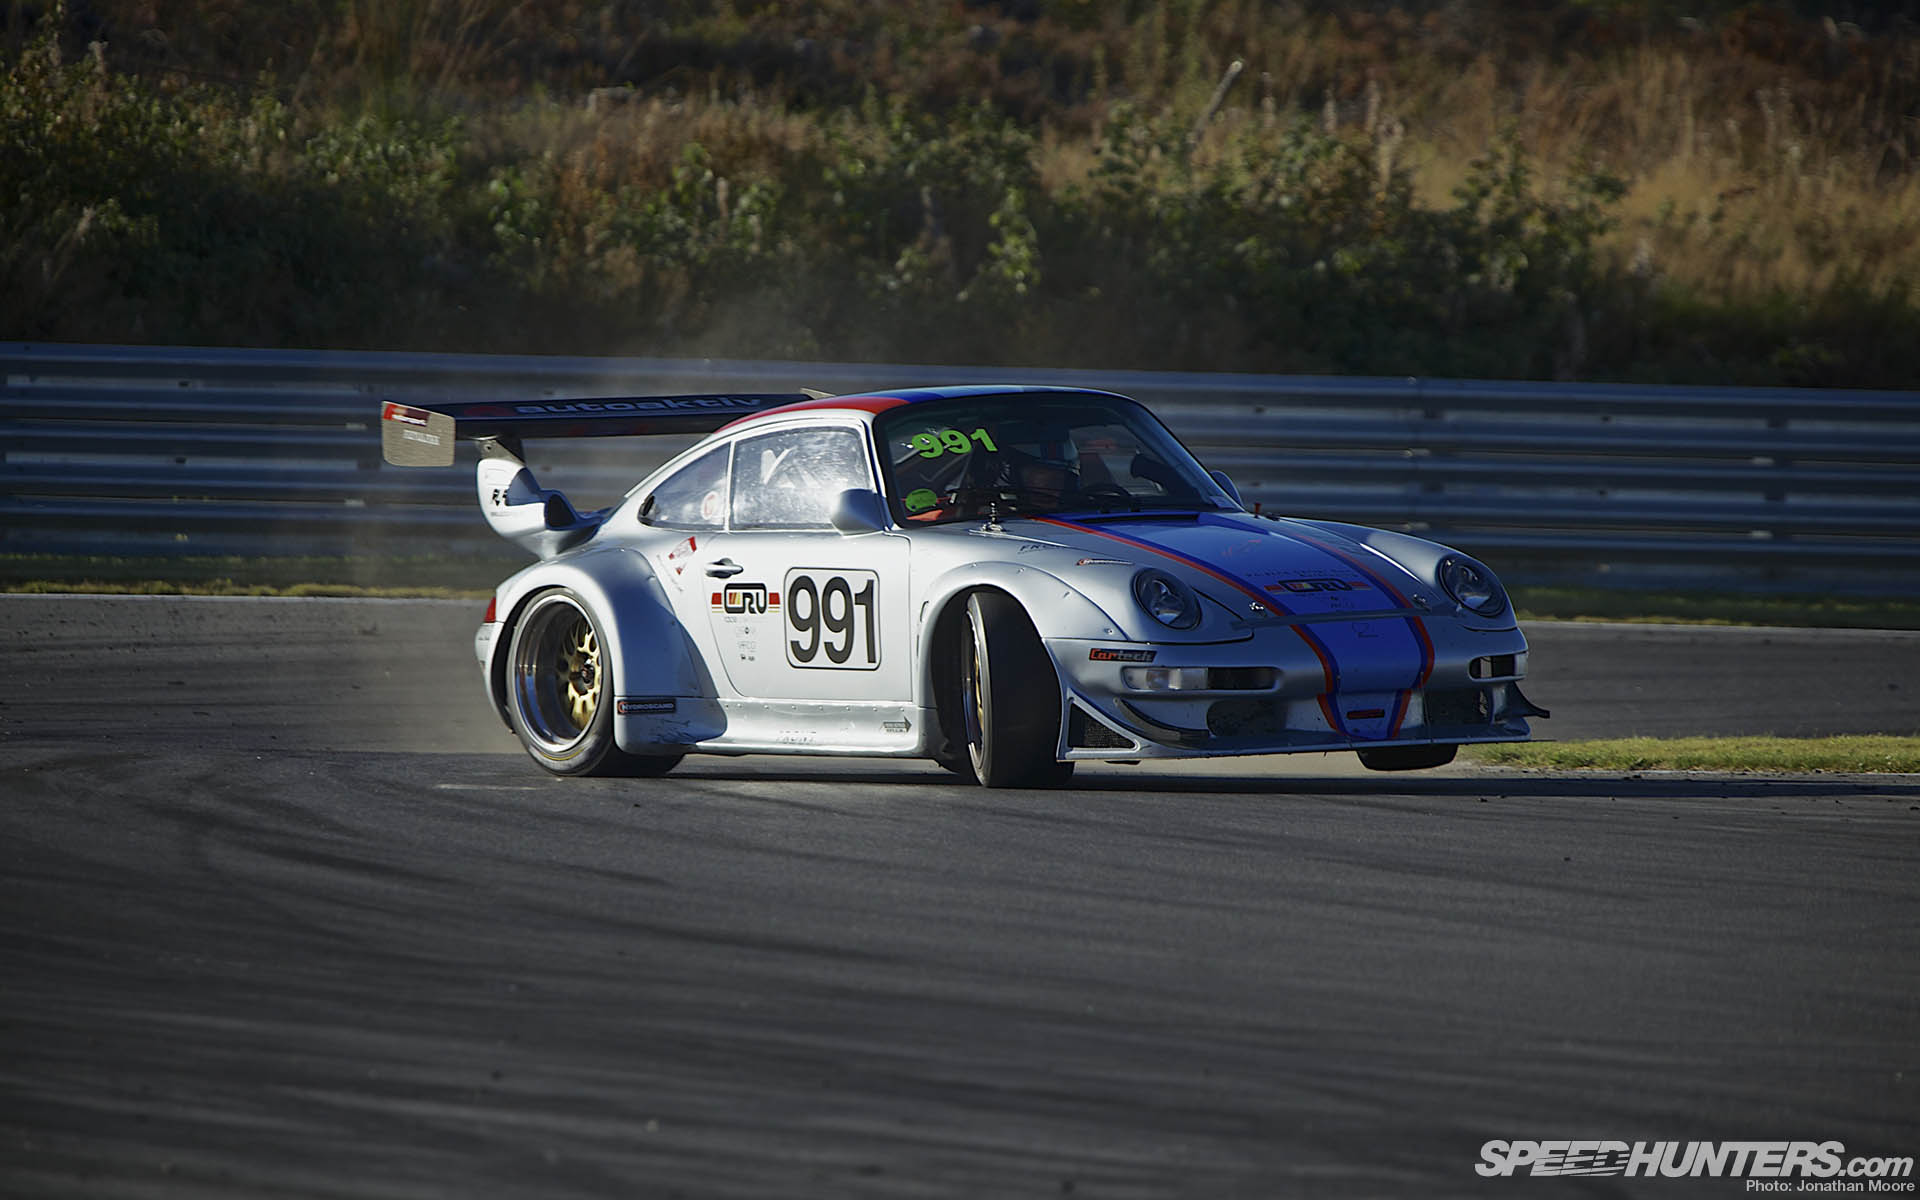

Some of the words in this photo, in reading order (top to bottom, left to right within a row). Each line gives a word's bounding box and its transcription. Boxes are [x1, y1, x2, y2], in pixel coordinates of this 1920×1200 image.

[515, 397, 761, 415] autoaktiv
[911, 428, 998, 459] 991
[788, 575, 877, 664] 991
[1090, 649, 1154, 661] Cartech
